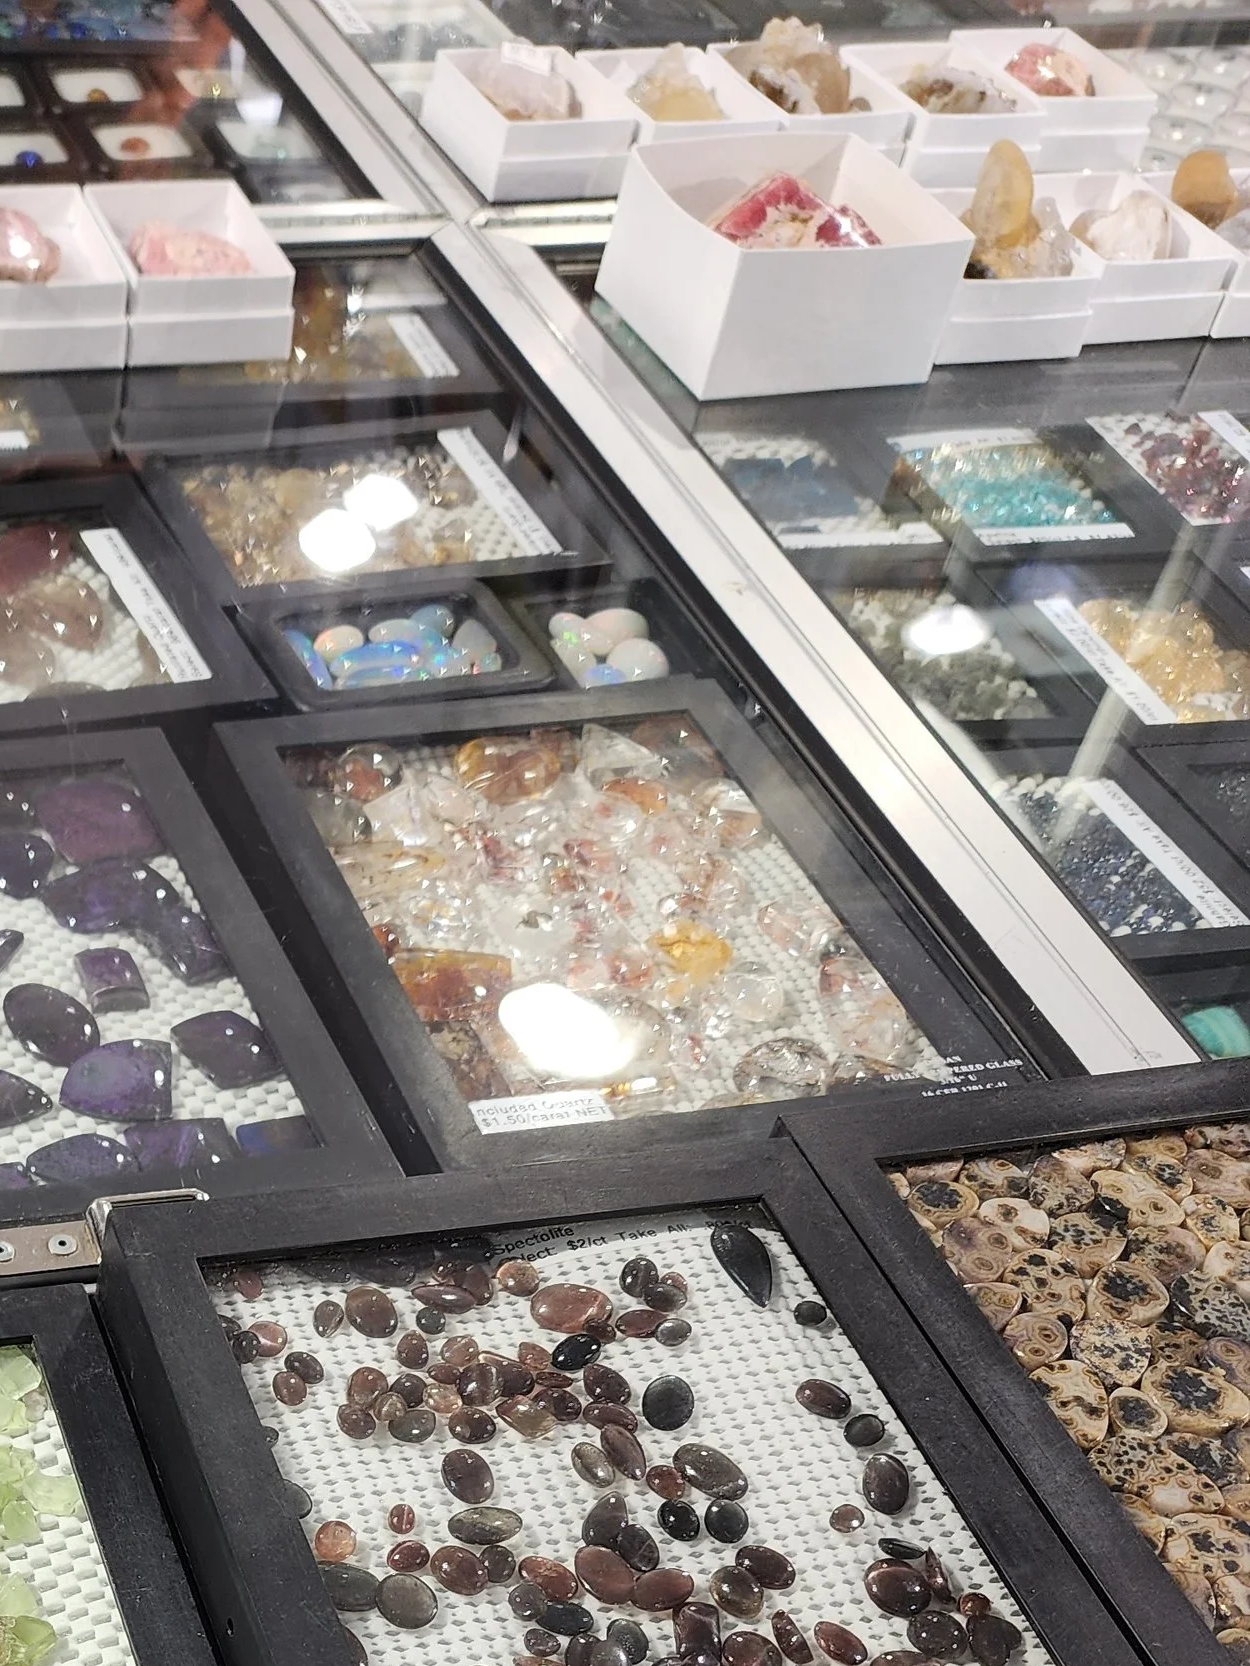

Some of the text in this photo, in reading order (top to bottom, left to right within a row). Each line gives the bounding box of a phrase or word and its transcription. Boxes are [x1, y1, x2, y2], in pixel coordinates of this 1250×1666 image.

[986, 1057, 1024, 1070] GLASS
[476, 1101, 538, 1117] ncluded
[481, 1105, 607, 1129] $1.50/carat NET
[491, 1226, 575, 1257] Spectolite
[566, 1235, 608, 1252] $2/ct
[613, 1228, 658, 1243] Take
